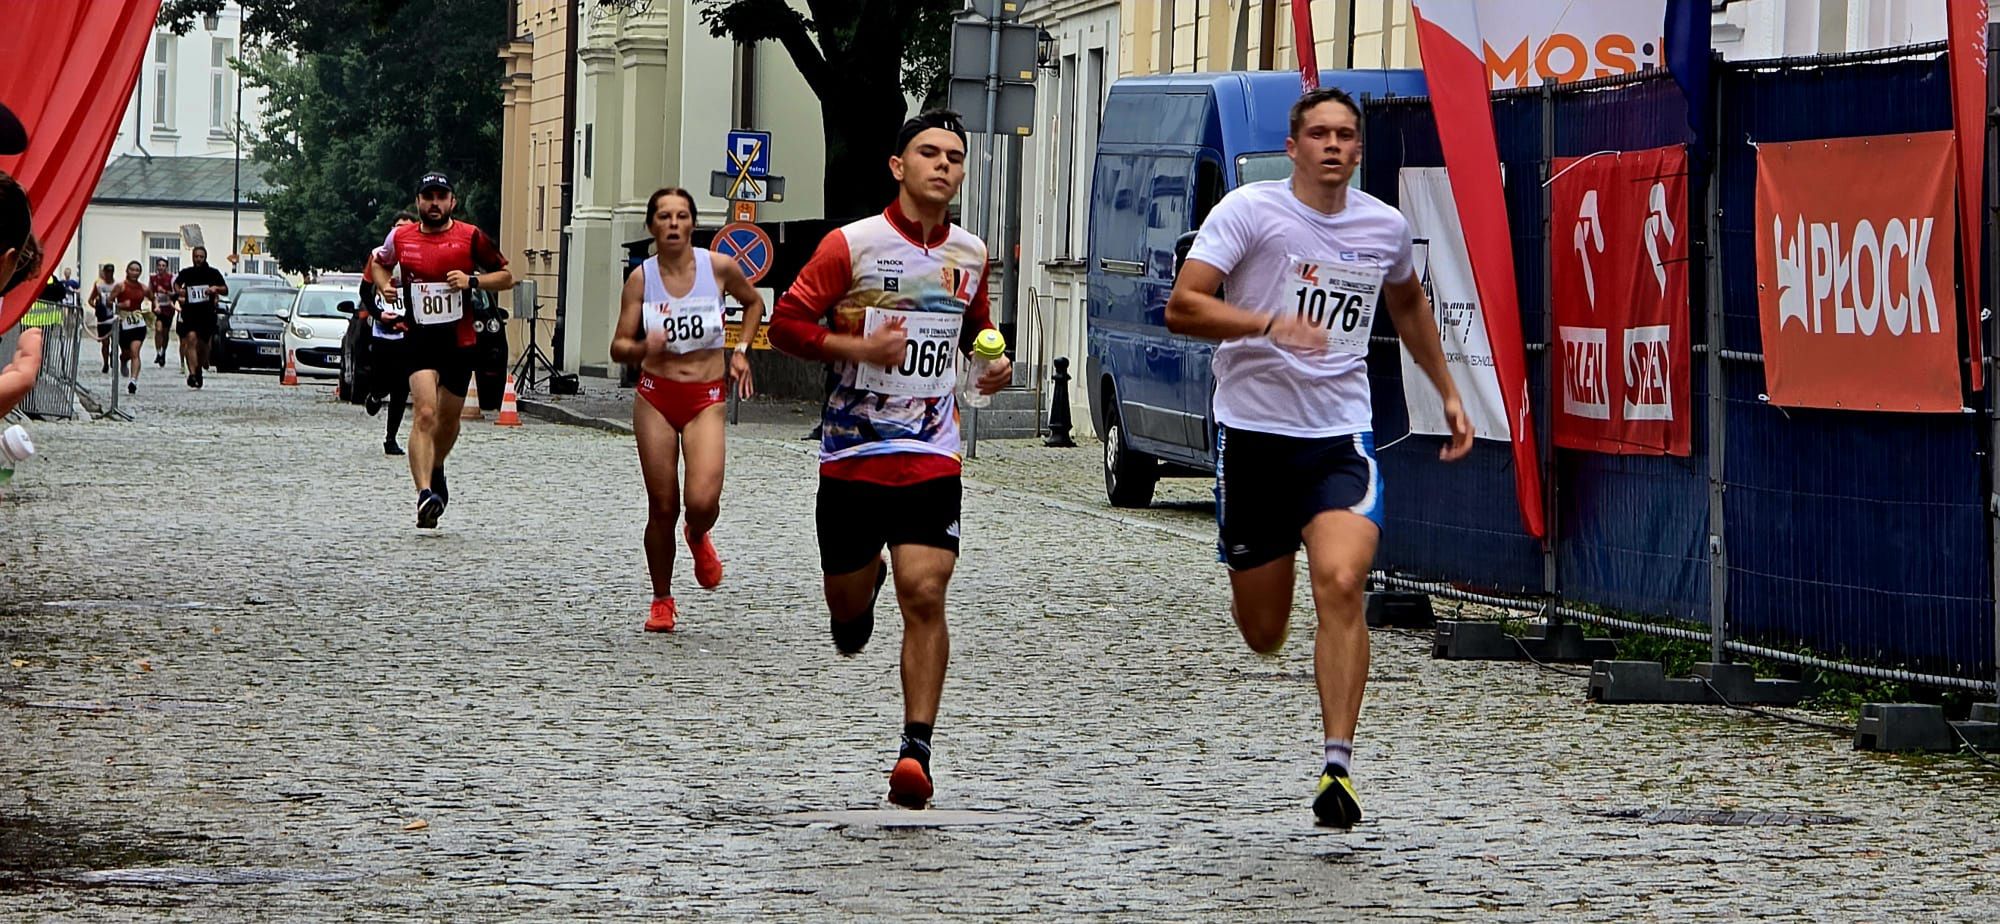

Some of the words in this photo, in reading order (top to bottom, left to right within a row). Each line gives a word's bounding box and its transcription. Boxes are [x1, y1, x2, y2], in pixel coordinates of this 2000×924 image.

[1482, 34, 1664, 88] MOSi
[1809, 217, 1940, 336] PŁOCK
[423, 294, 452, 315] 801
[1295, 286, 1363, 333] 1076
[884, 338, 949, 378] 066
